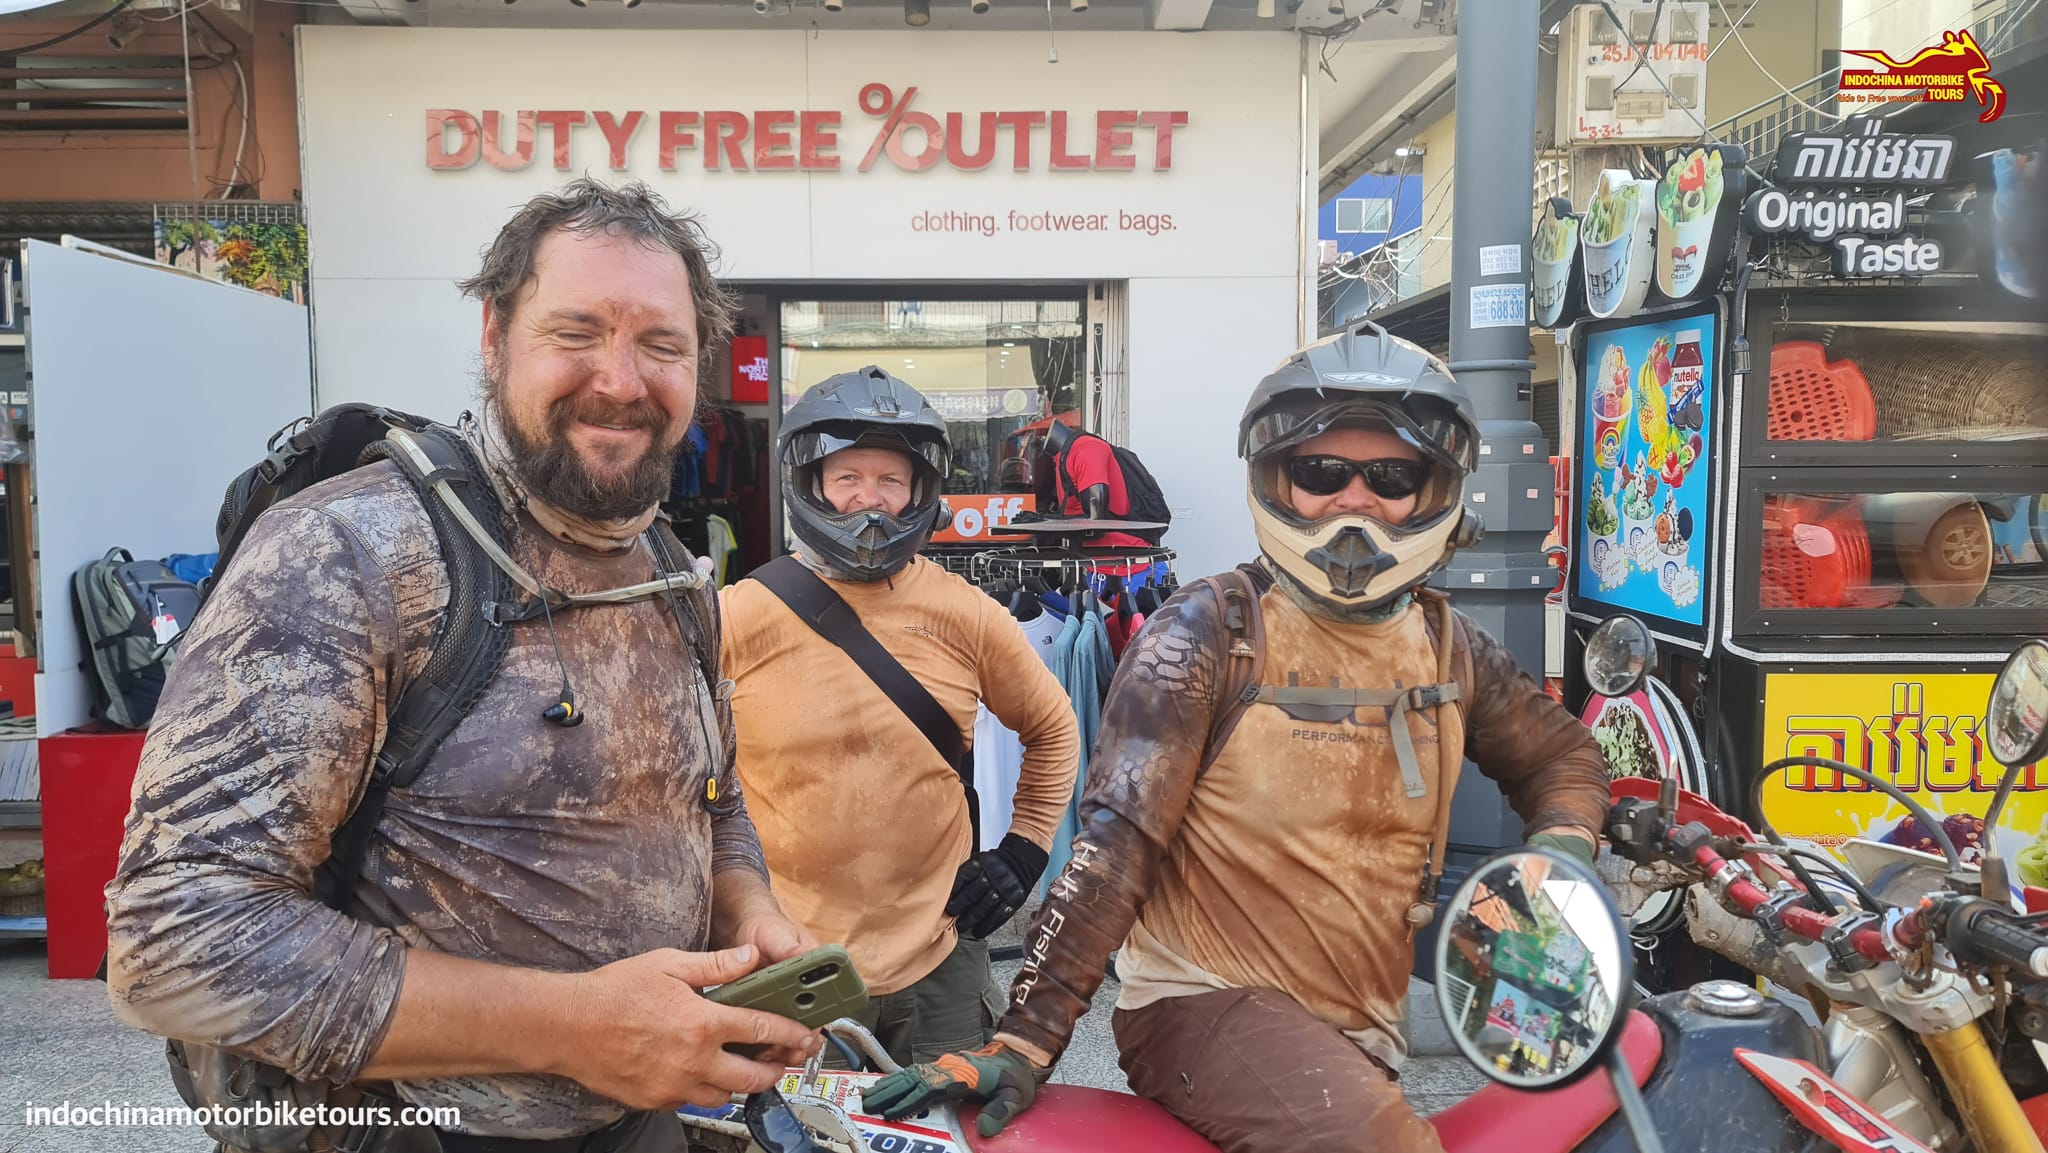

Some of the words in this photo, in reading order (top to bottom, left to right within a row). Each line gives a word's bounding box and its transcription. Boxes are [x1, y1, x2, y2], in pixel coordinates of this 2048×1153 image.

[426, 108, 646, 172] DUTY
[659, 110, 842, 172] FREE
[912, 210, 1000, 236] clothing.
[1119, 209, 1177, 236] bags.
[1758, 192, 1903, 237] Original
[1839, 237, 1940, 273] Taste
[739, 365, 768, 375] NORT
[1674, 368, 1699, 382] nutella
[954, 498, 1025, 538] off
[1292, 729, 1393, 745] PERFORMANCE
[1413, 734, 1440, 745] HING
